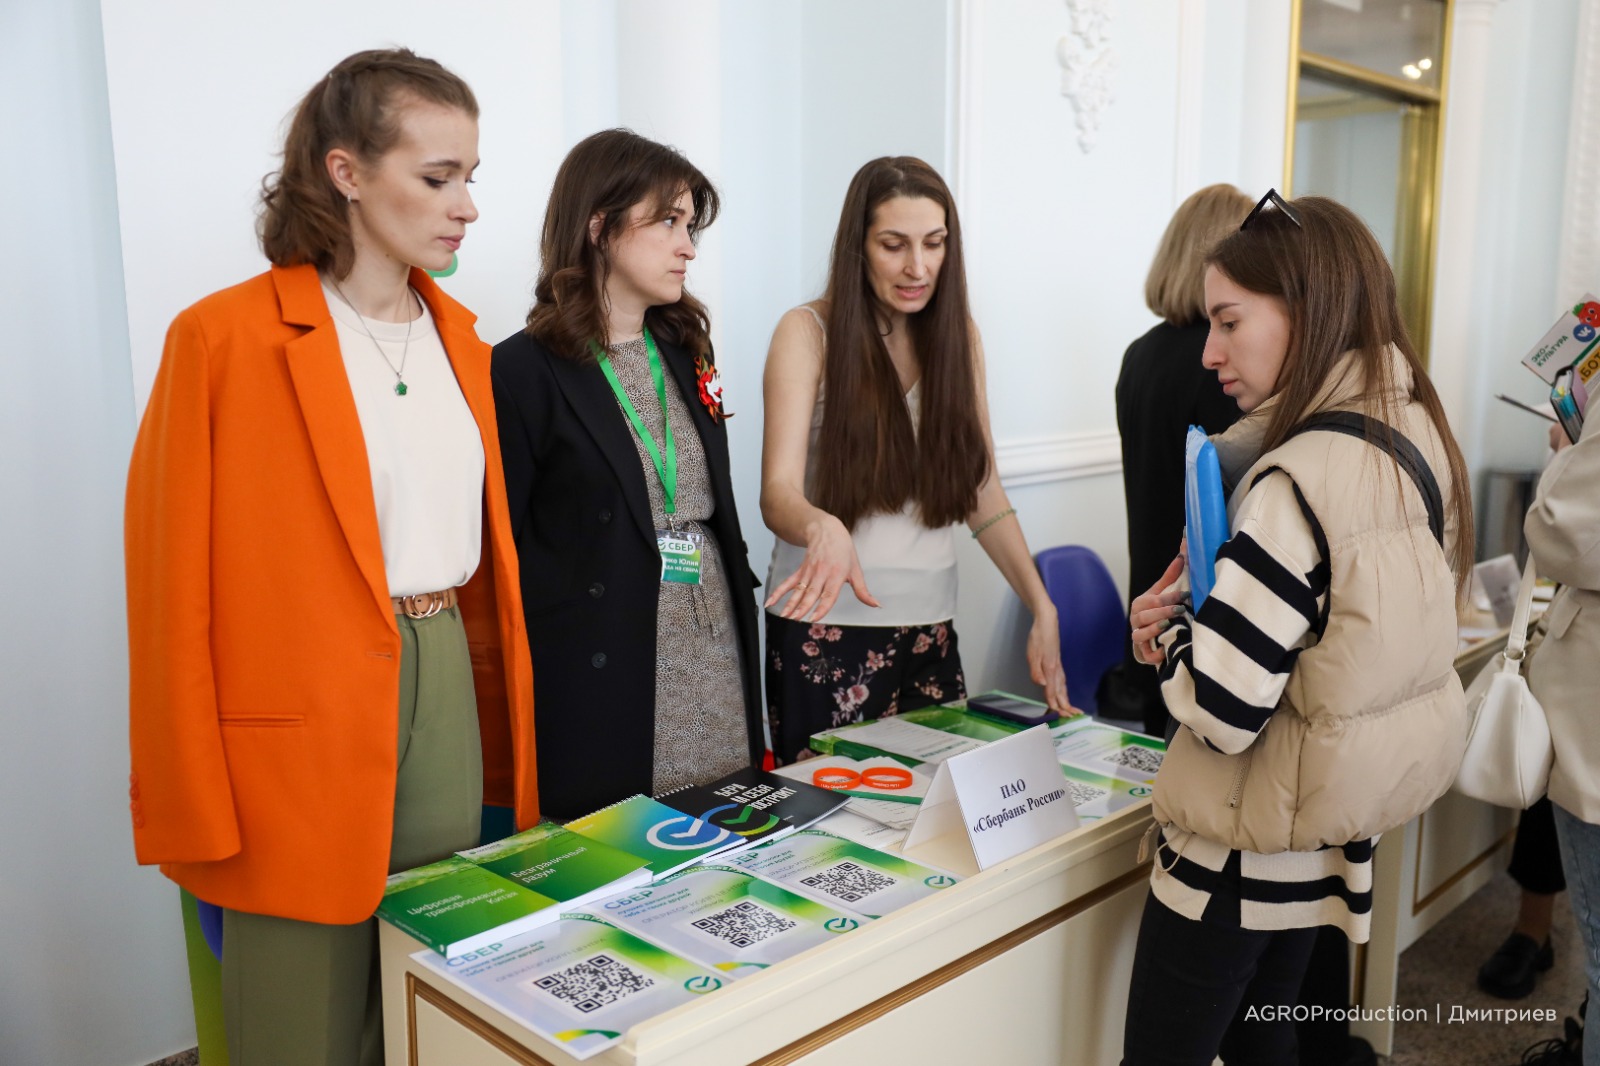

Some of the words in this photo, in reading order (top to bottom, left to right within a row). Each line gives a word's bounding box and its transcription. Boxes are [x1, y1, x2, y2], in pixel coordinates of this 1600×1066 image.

[1531, 344, 1549, 362] ЭКО-
[1537, 335, 1569, 367] КУЛЬТУРА
[668, 542, 694, 552] СБЕР
[741, 784, 775, 799] СЕБЯ
[1000, 778, 1026, 799] ПАО
[973, 804, 1027, 833] «Сбербанк
[1026, 788, 1065, 811] России»
[510, 845, 588, 878] Безграничный
[521, 868, 556, 883] разум
[407, 894, 462, 915] Цифровая
[424, 888, 506, 918] трансформация
[486, 891, 518, 905] Китая
[604, 890, 653, 909] СБЕР
[446, 942, 503, 967] СБЕР
